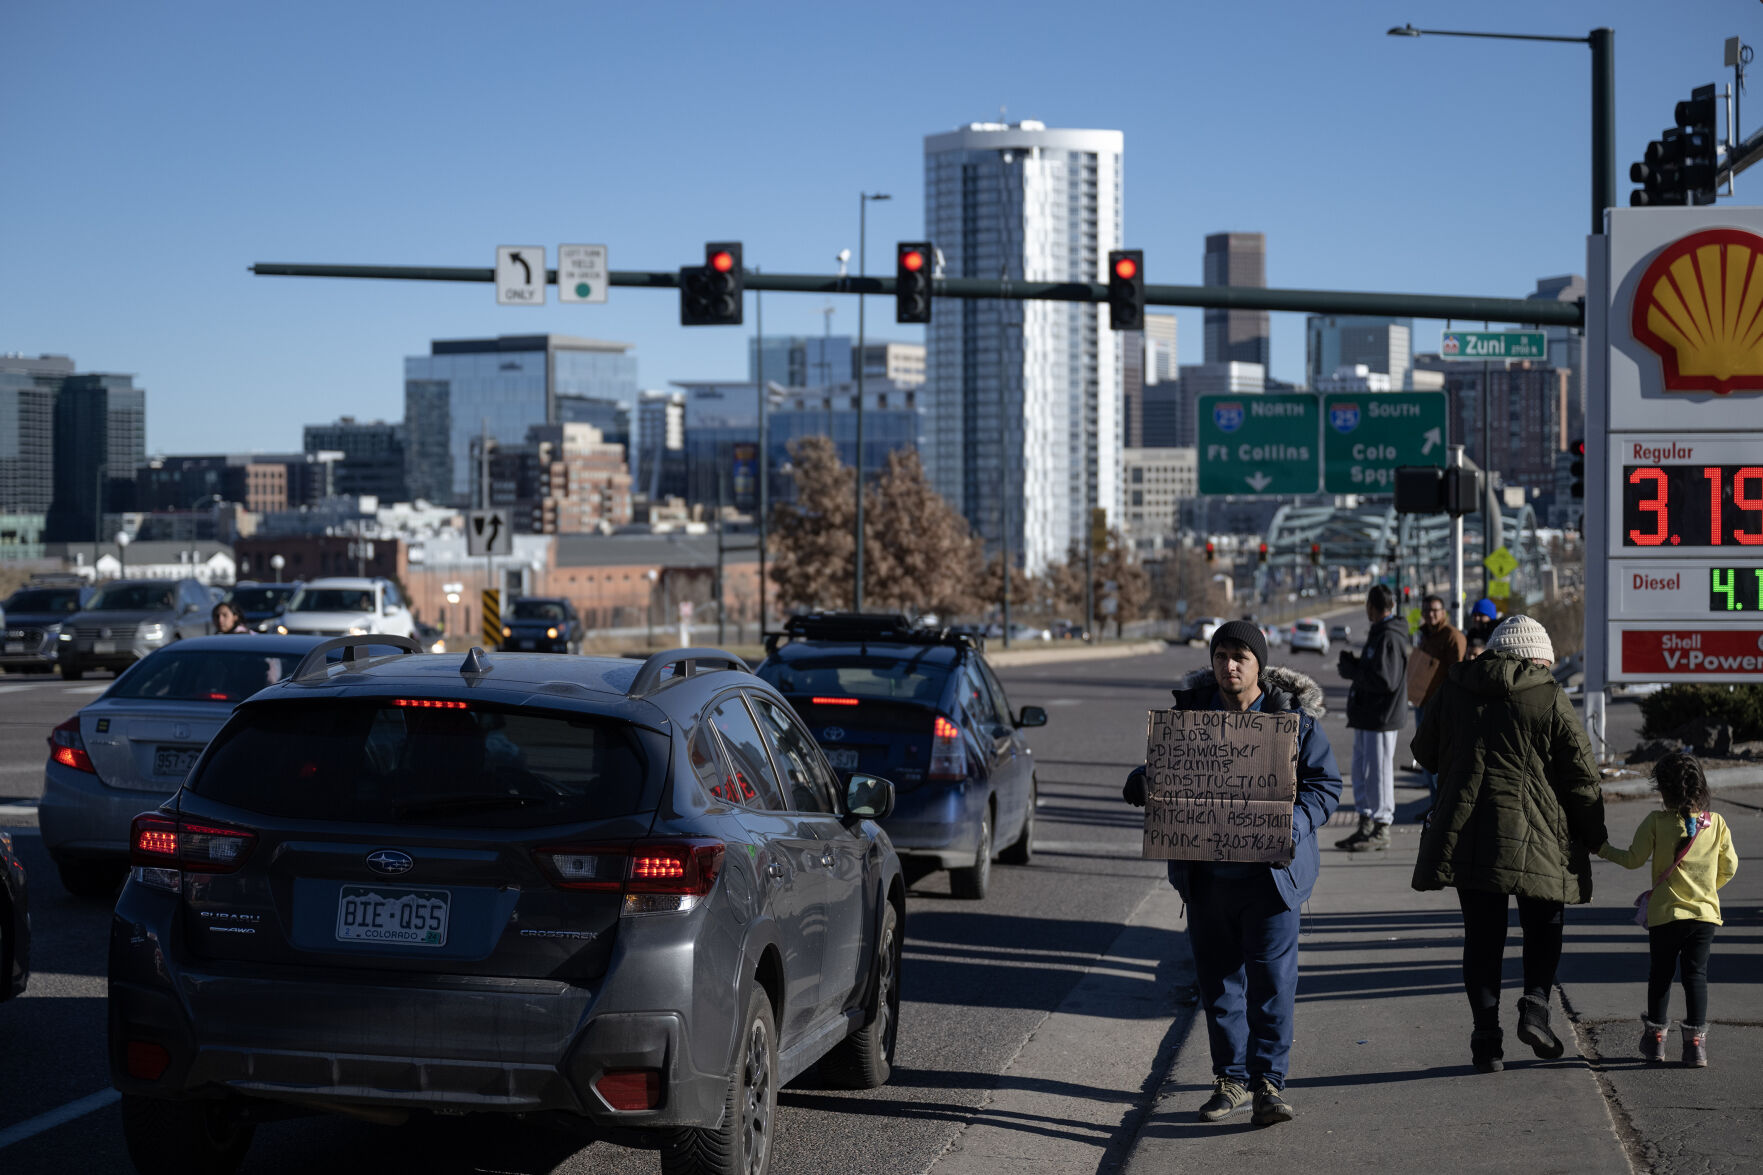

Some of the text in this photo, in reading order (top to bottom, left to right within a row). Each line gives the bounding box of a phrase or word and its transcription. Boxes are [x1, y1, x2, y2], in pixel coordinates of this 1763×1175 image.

[505, 289, 535, 300] ONLY
[1465, 335, 1505, 355] Zuni
[1219, 410, 1239, 426] 25
[1335, 410, 1355, 426] 25
[1207, 444, 1309, 461] Ft Collins
[1352, 443, 1397, 461] Colo
[1633, 442, 1693, 463] Regular
[1633, 573, 1680, 590] Diesel
[1662, 633, 1701, 649] Shell
[1663, 650, 1763, 670] V-Power
[1194, 712, 1265, 731] LOOKING
[1269, 717, 1298, 733] FOR
[1163, 726, 1172, 741] A
[364, 930, 418, 940] COLORADO
